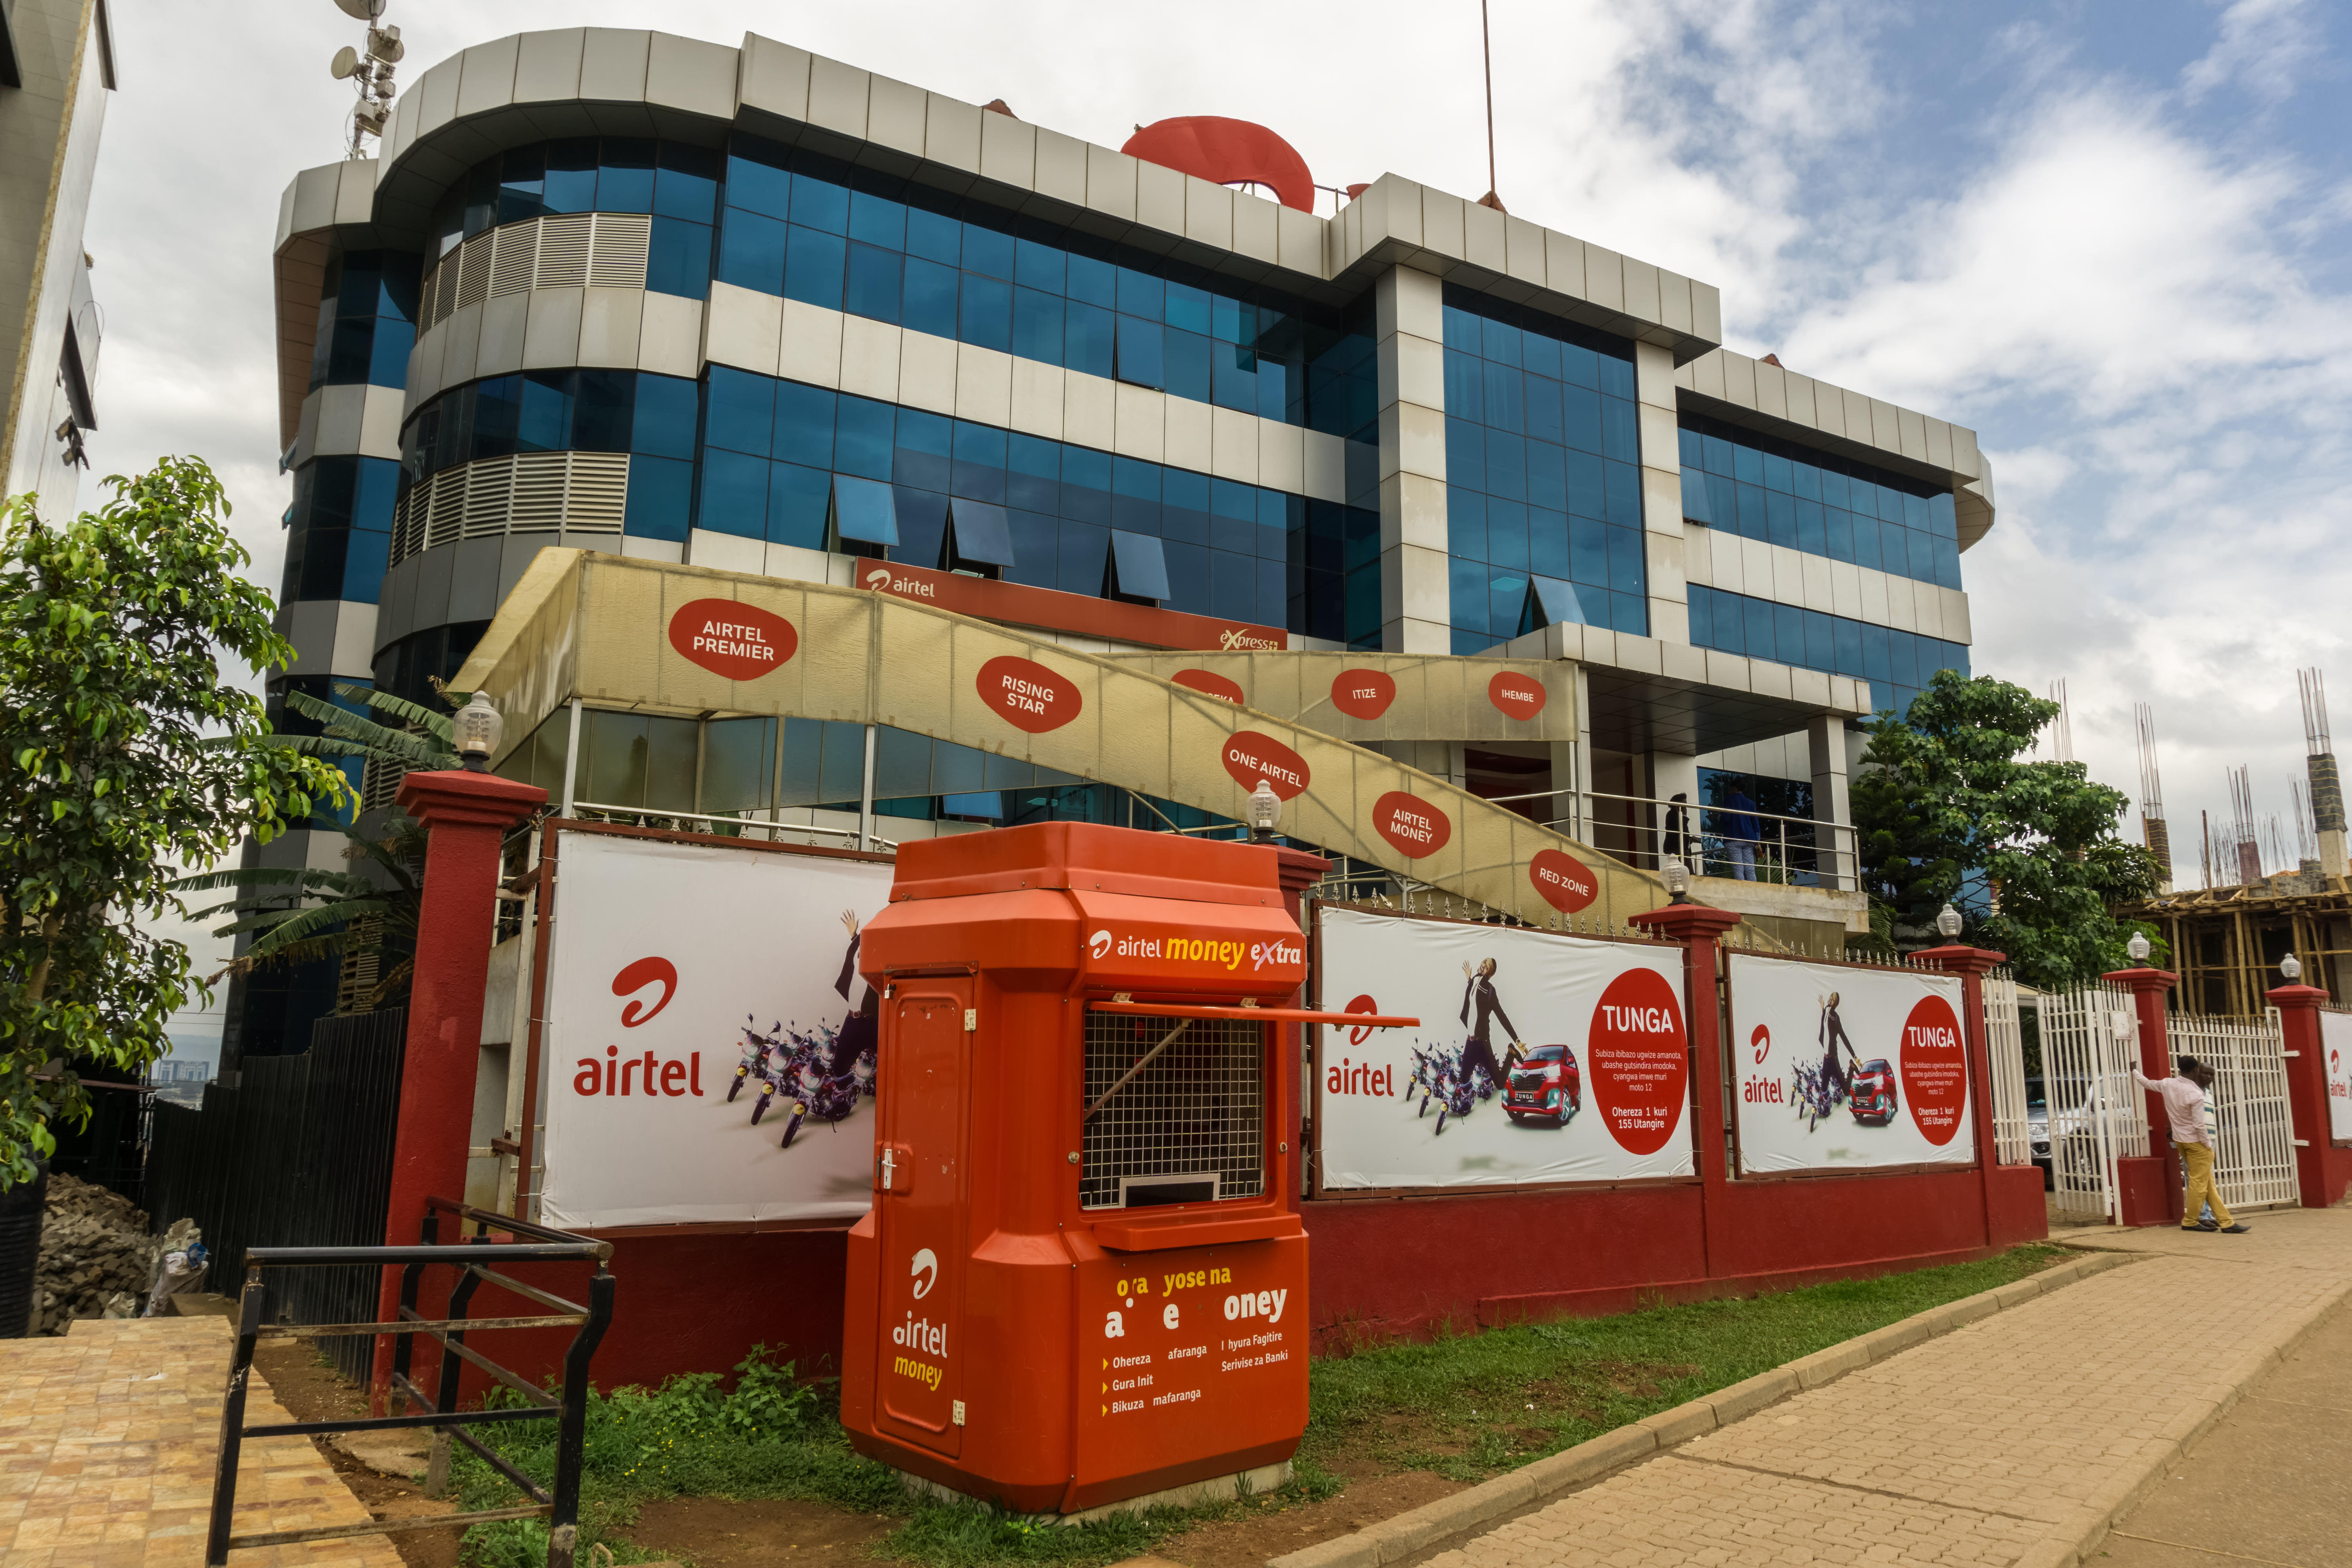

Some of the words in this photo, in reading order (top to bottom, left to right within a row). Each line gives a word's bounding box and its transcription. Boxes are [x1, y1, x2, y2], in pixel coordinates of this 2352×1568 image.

[893, 577, 935, 597] airtel
[702, 621, 766, 642] AIRTEL
[693, 636, 774, 661] PREMIER
[1002, 675, 1054, 703] RISING
[1352, 688, 1376, 699] ITIZE
[1502, 689, 1534, 703] IHEMBE
[1007, 693, 1044, 715] STAR
[1230, 749, 1258, 769] ONE
[1259, 762, 1302, 788] AIRTEL
[1393, 809, 1432, 830] AIRTEL
[1390, 821, 1433, 844] MONEY
[1539, 867, 1559, 884] RED
[1561, 876, 1589, 897] ZONE
[1117, 935, 1161, 958] airtel
[1166, 938, 1245, 970] money
[1602, 1005, 1674, 1033] TUNGA
[1908, 1026, 1956, 1047] TUNGA
[1595, 1049, 1614, 1057] Subiza
[1615, 1050, 1635, 1058] ibibazo
[1637, 1051, 1656, 1060] ugwize
[573, 1045, 704, 1097] airtel
[1624, 1061, 1651, 1071] gutsindira
[1652, 1062, 1677, 1070] imodoka,
[1327, 1058, 1394, 1097] airtel
[1613, 1073, 1638, 1082] cyangwa
[2330, 1079, 2347, 1097] airtel
[1744, 1074, 1784, 1103] airtel
[1612, 1107, 1642, 1116] Ohereza
[1646, 1107, 1650, 1116] 1
[1654, 1106, 1667, 1116] kuri
[1918, 1107, 1938, 1116] Ohereza
[1933, 1116, 1953, 1126] Utangire
[1619, 1119, 1632, 1129] 155
[1634, 1118, 1664, 1131] Utangire
[1210, 1267, 1231, 1285] na
[893, 1310, 947, 1358] airtel
[1253, 1331, 1282, 1346] Fagitire
[1113, 1354, 1151, 1368] Ohereza
[1221, 1357, 1253, 1372] Serivise
[1254, 1357, 1263, 1366] za
[1265, 1349, 1288, 1363] Banki
[894, 1356, 942, 1391] money
[1112, 1379, 1135, 1391] Gura
[1112, 1399, 1144, 1414] Bikuza
[1153, 1389, 1201, 1406] mafaranga
